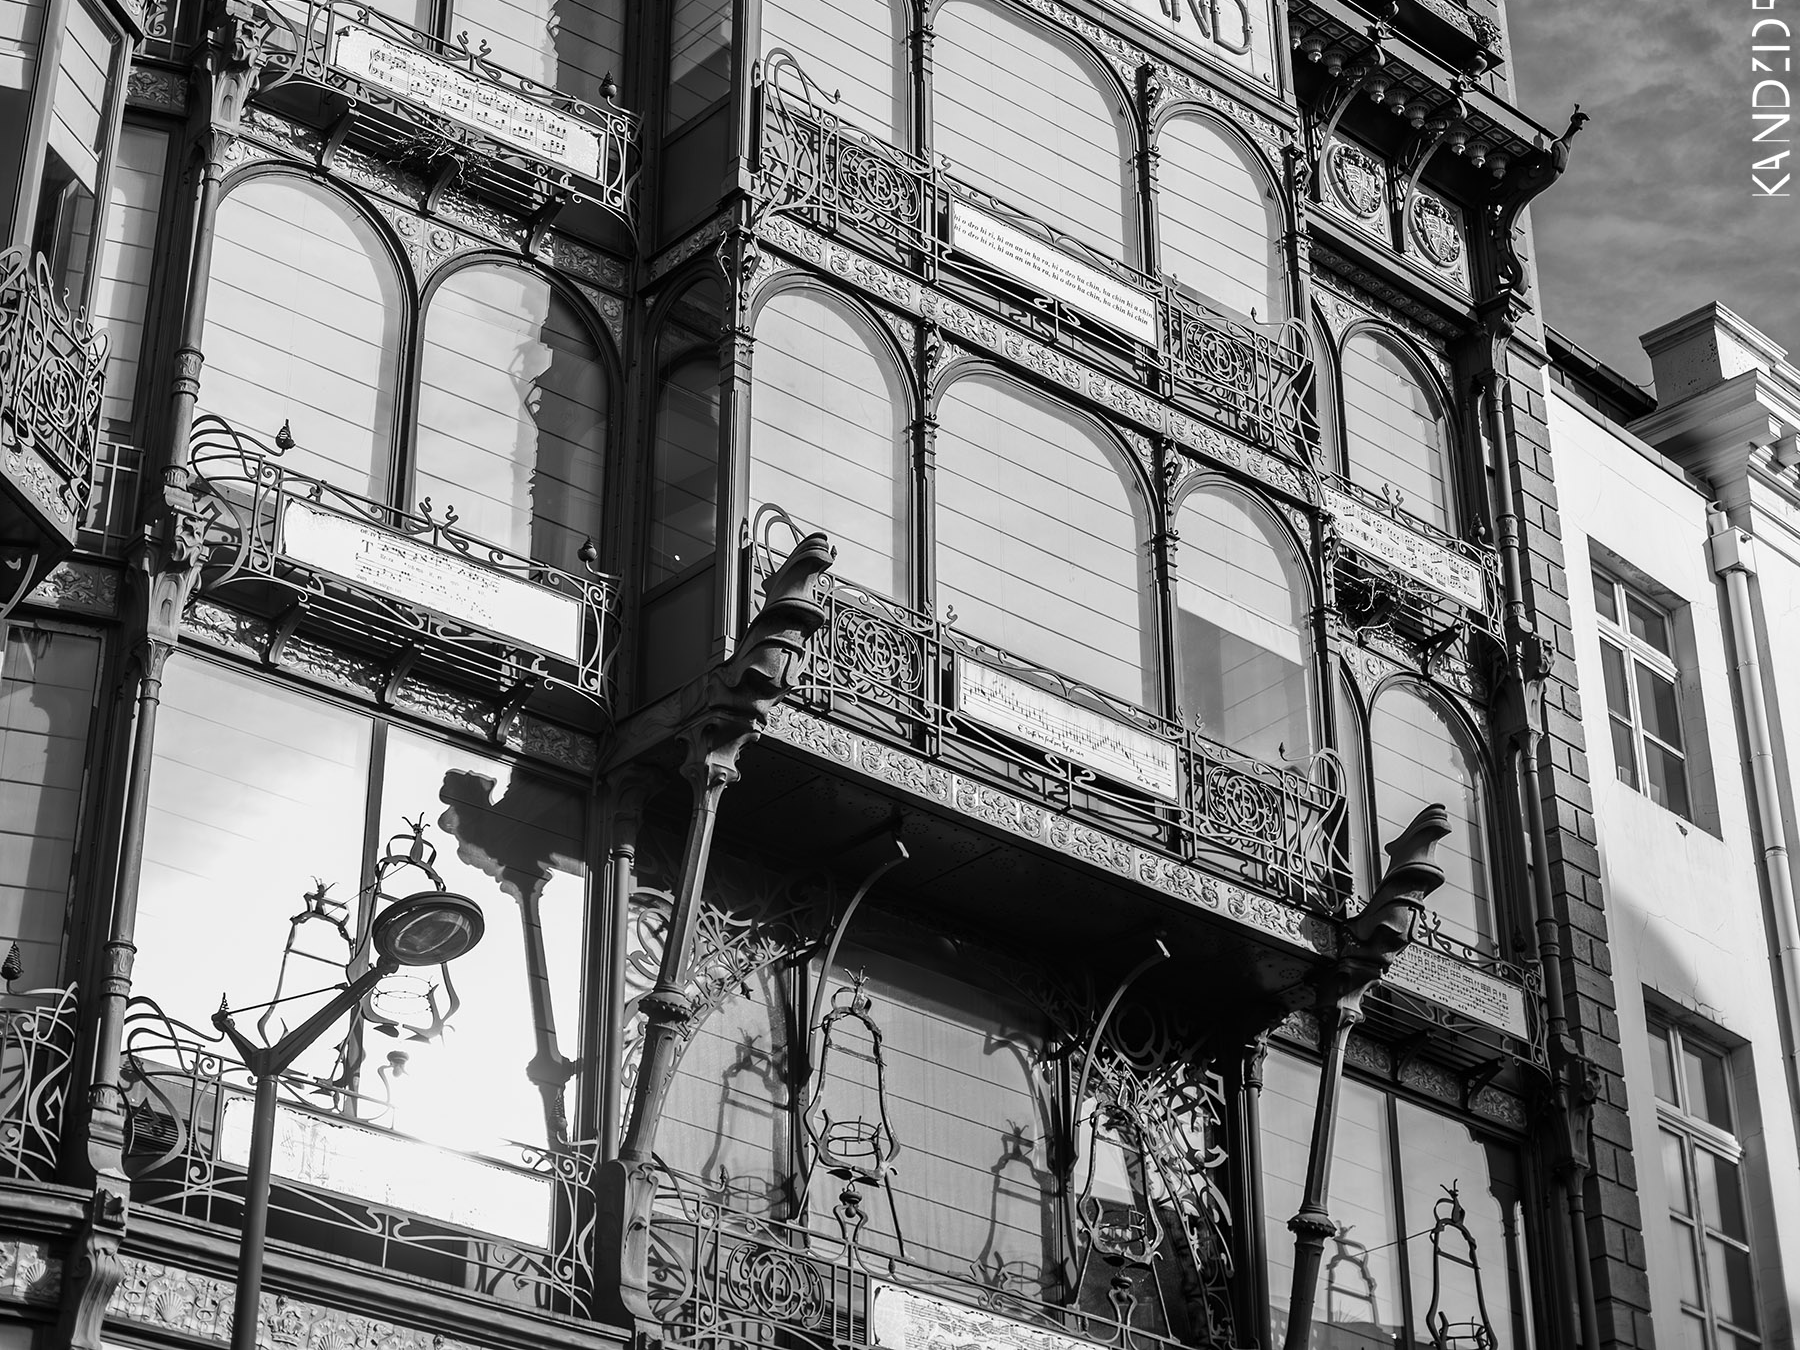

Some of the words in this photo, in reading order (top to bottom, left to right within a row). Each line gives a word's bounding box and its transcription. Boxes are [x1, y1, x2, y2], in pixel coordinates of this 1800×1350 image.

[980, 227, 987, 235] hi
[997, 235, 1004, 243] hi
[1015, 245, 1023, 253] an
[1032, 253, 1040, 262] ha
[1077, 275, 1085, 284] ha
[1103, 288, 1111, 297] ha
[1112, 294, 1125, 304] chin
[1127, 300, 1133, 308] hi
[997, 245, 1004, 253] hi
[1032, 263, 1041, 271] ha
[1052, 272, 1059, 280] hi
[1077, 285, 1085, 294] ha
[1103, 298, 1111, 307] ha
[1112, 304, 1125, 314] chin
[1127, 310, 1133, 318] hi
